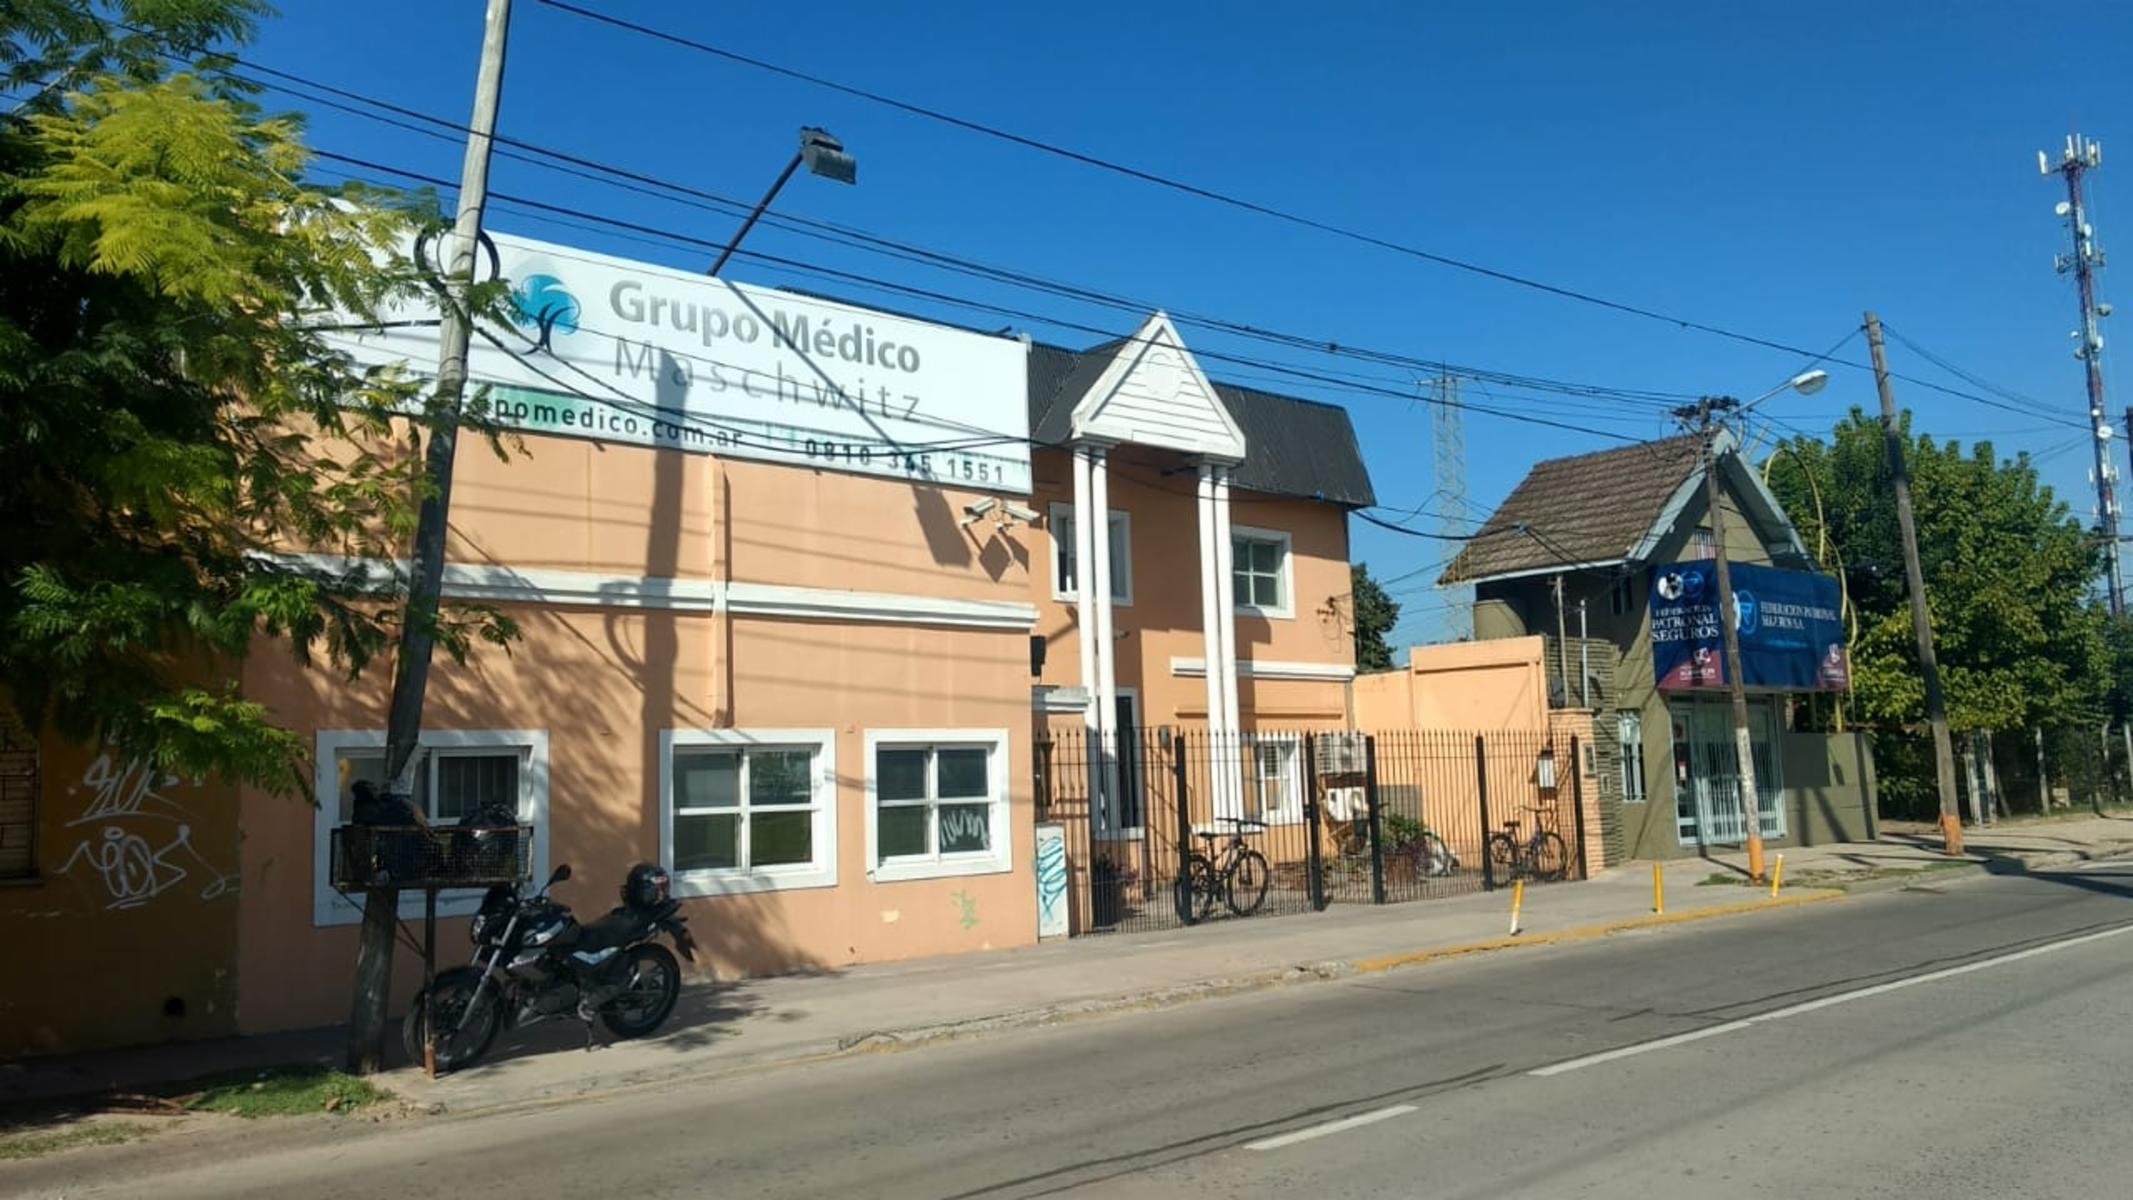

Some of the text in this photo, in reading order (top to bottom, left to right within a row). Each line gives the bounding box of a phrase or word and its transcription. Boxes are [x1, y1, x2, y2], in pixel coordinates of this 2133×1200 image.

[609, 280, 921, 373] Grupo Médico
[614, 335, 921, 422] Maschwitz
[494, 398, 743, 448] pomedico.com.ar
[947, 457, 1003, 484] 1551
[1651, 612, 1719, 630] PATRONAL
[1651, 624, 1720, 642] SEGUROS
